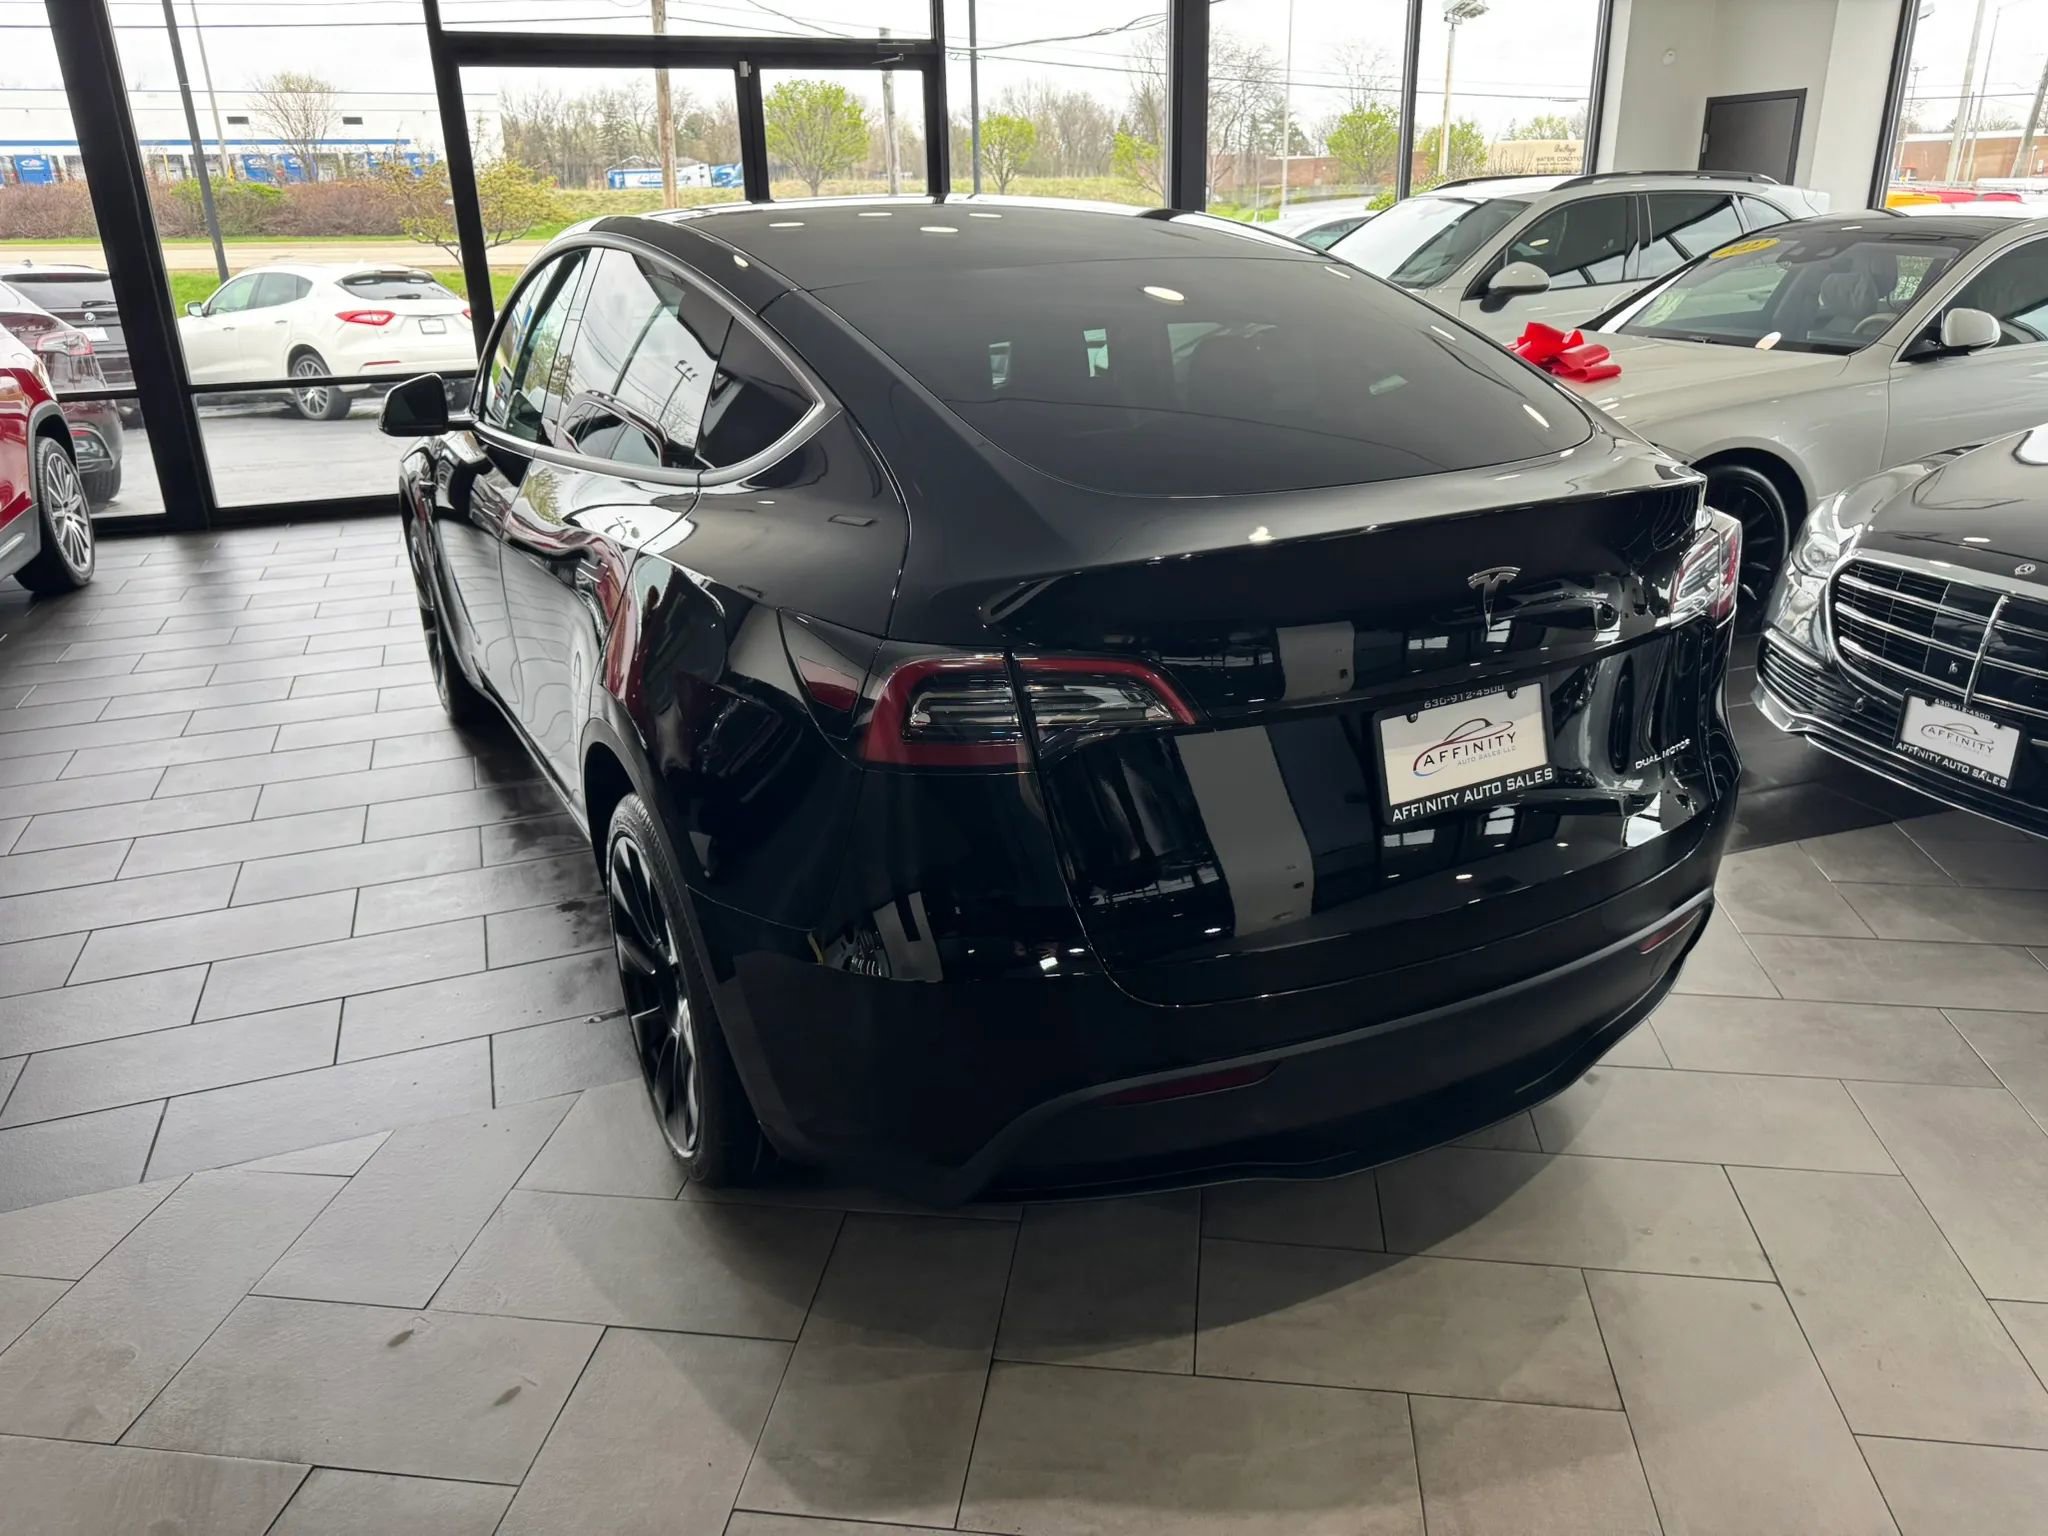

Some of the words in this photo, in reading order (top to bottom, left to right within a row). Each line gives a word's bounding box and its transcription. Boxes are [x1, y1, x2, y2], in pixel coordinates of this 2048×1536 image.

[1424, 731, 1516, 766] AFFINITY
[1635, 753, 1662, 769] DUAL
[1662, 738, 1690, 758] MOTOR
[1928, 726, 1995, 753] AFFINITY
[1457, 756, 1476, 766] AUTO
[1478, 748, 1501, 760] SALES
[1895, 742, 1941, 763] AFFINITY
[1942, 757, 1970, 773] AUTO
[1971, 767, 2007, 788] SALES
[1392, 792, 1459, 822] AFFINITY
[1464, 781, 1502, 804] AUTO
[1506, 767, 1553, 791] SALES
